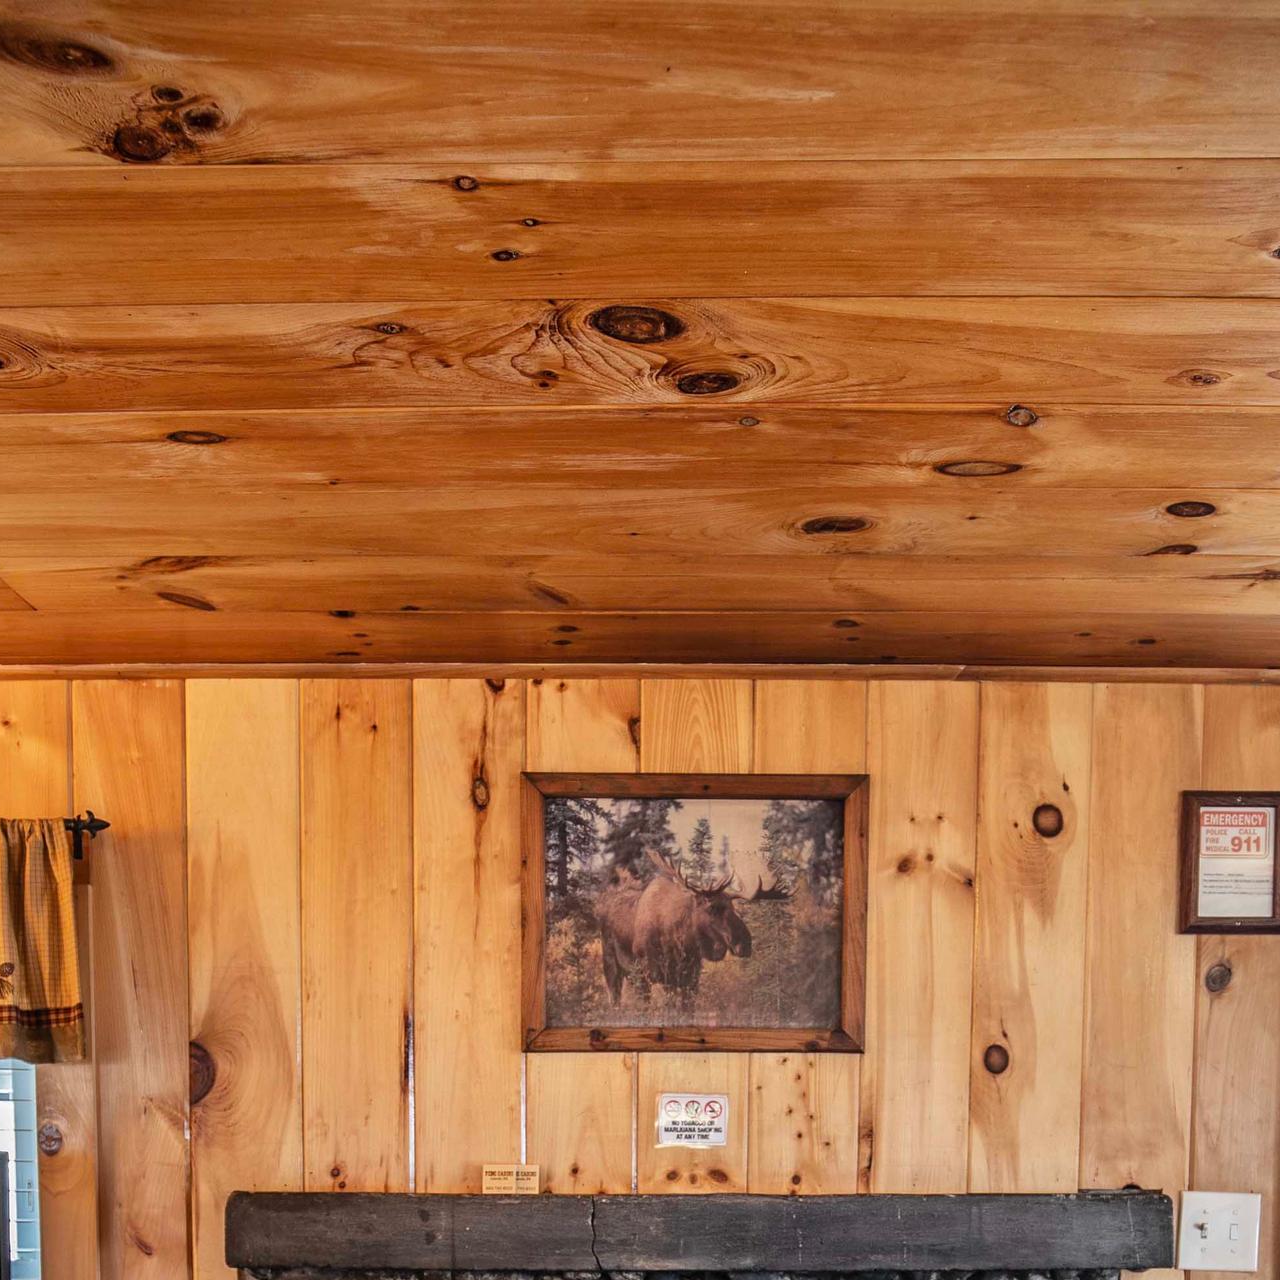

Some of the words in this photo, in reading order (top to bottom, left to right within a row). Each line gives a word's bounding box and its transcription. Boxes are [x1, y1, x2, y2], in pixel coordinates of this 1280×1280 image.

[1203, 813, 1264, 826] EMERGENCY
[1205, 828, 1228, 836] POLICE
[1230, 835, 1261, 853] 911
